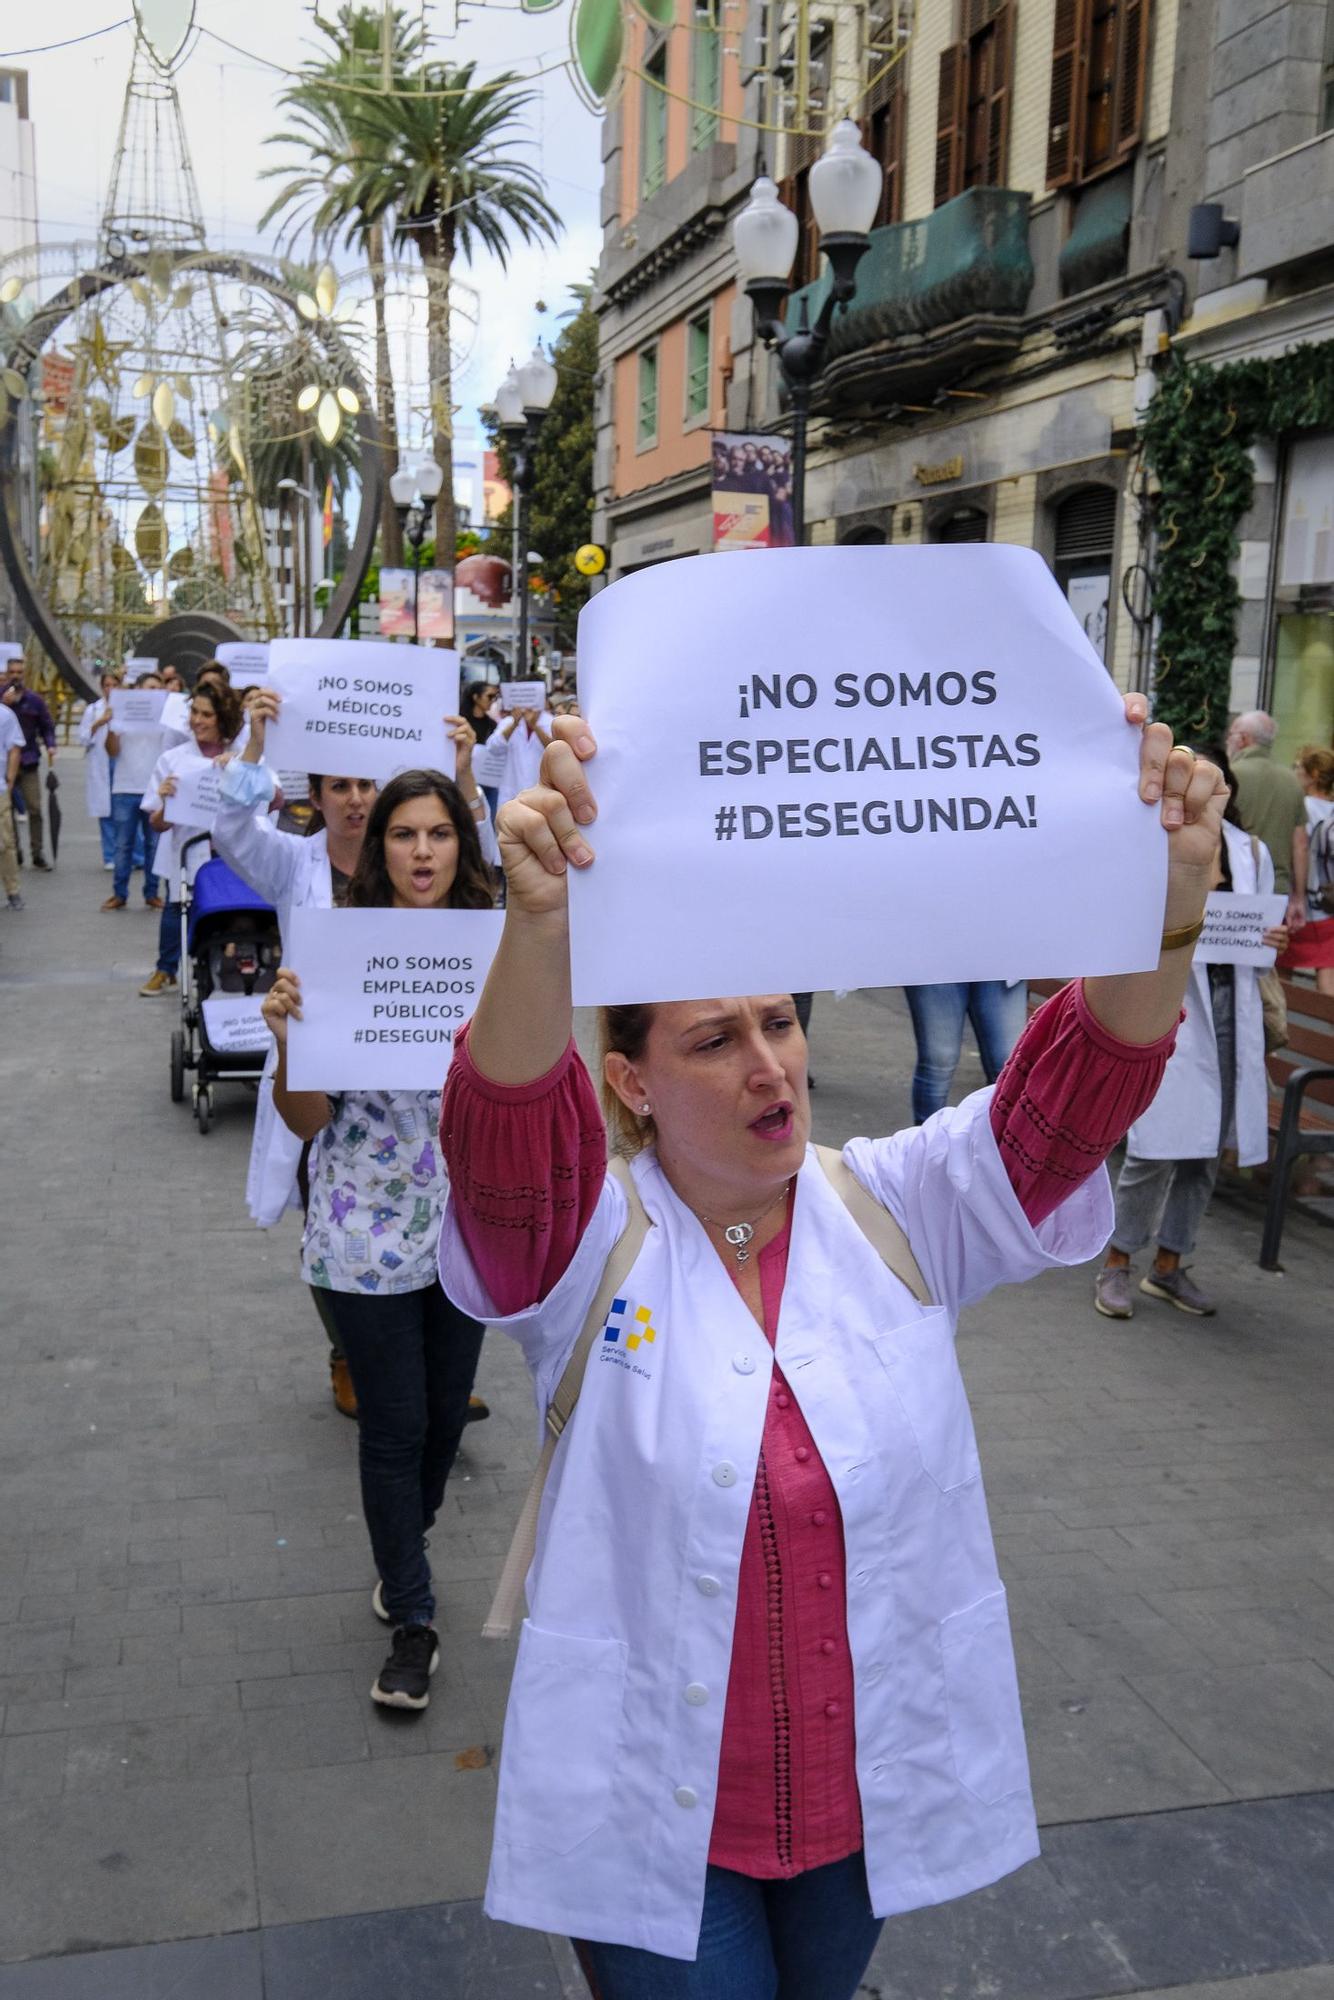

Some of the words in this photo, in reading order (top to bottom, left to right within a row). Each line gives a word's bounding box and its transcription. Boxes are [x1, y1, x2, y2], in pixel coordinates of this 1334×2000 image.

[318, 676, 348, 691] ¡NO
[353, 679, 413, 697] SOMOS
[738, 674, 818, 718] ¡NO
[834, 670, 997, 708] SOMOS
[327, 697, 403, 718] MÉDICOS
[305, 719, 423, 741] #DESEGUNDA!
[698, 733, 1041, 777] ESPECIALISTAS
[714, 794, 1039, 841] #DESEGUNDA!
[366, 956, 400, 973] ¡NO
[405, 956, 474, 971] SOMOS
[363, 980, 476, 994] EMPLEADOS
[373, 1001, 465, 1018] PÚBLICOS
[354, 1029, 455, 1043] #DESEGUN
